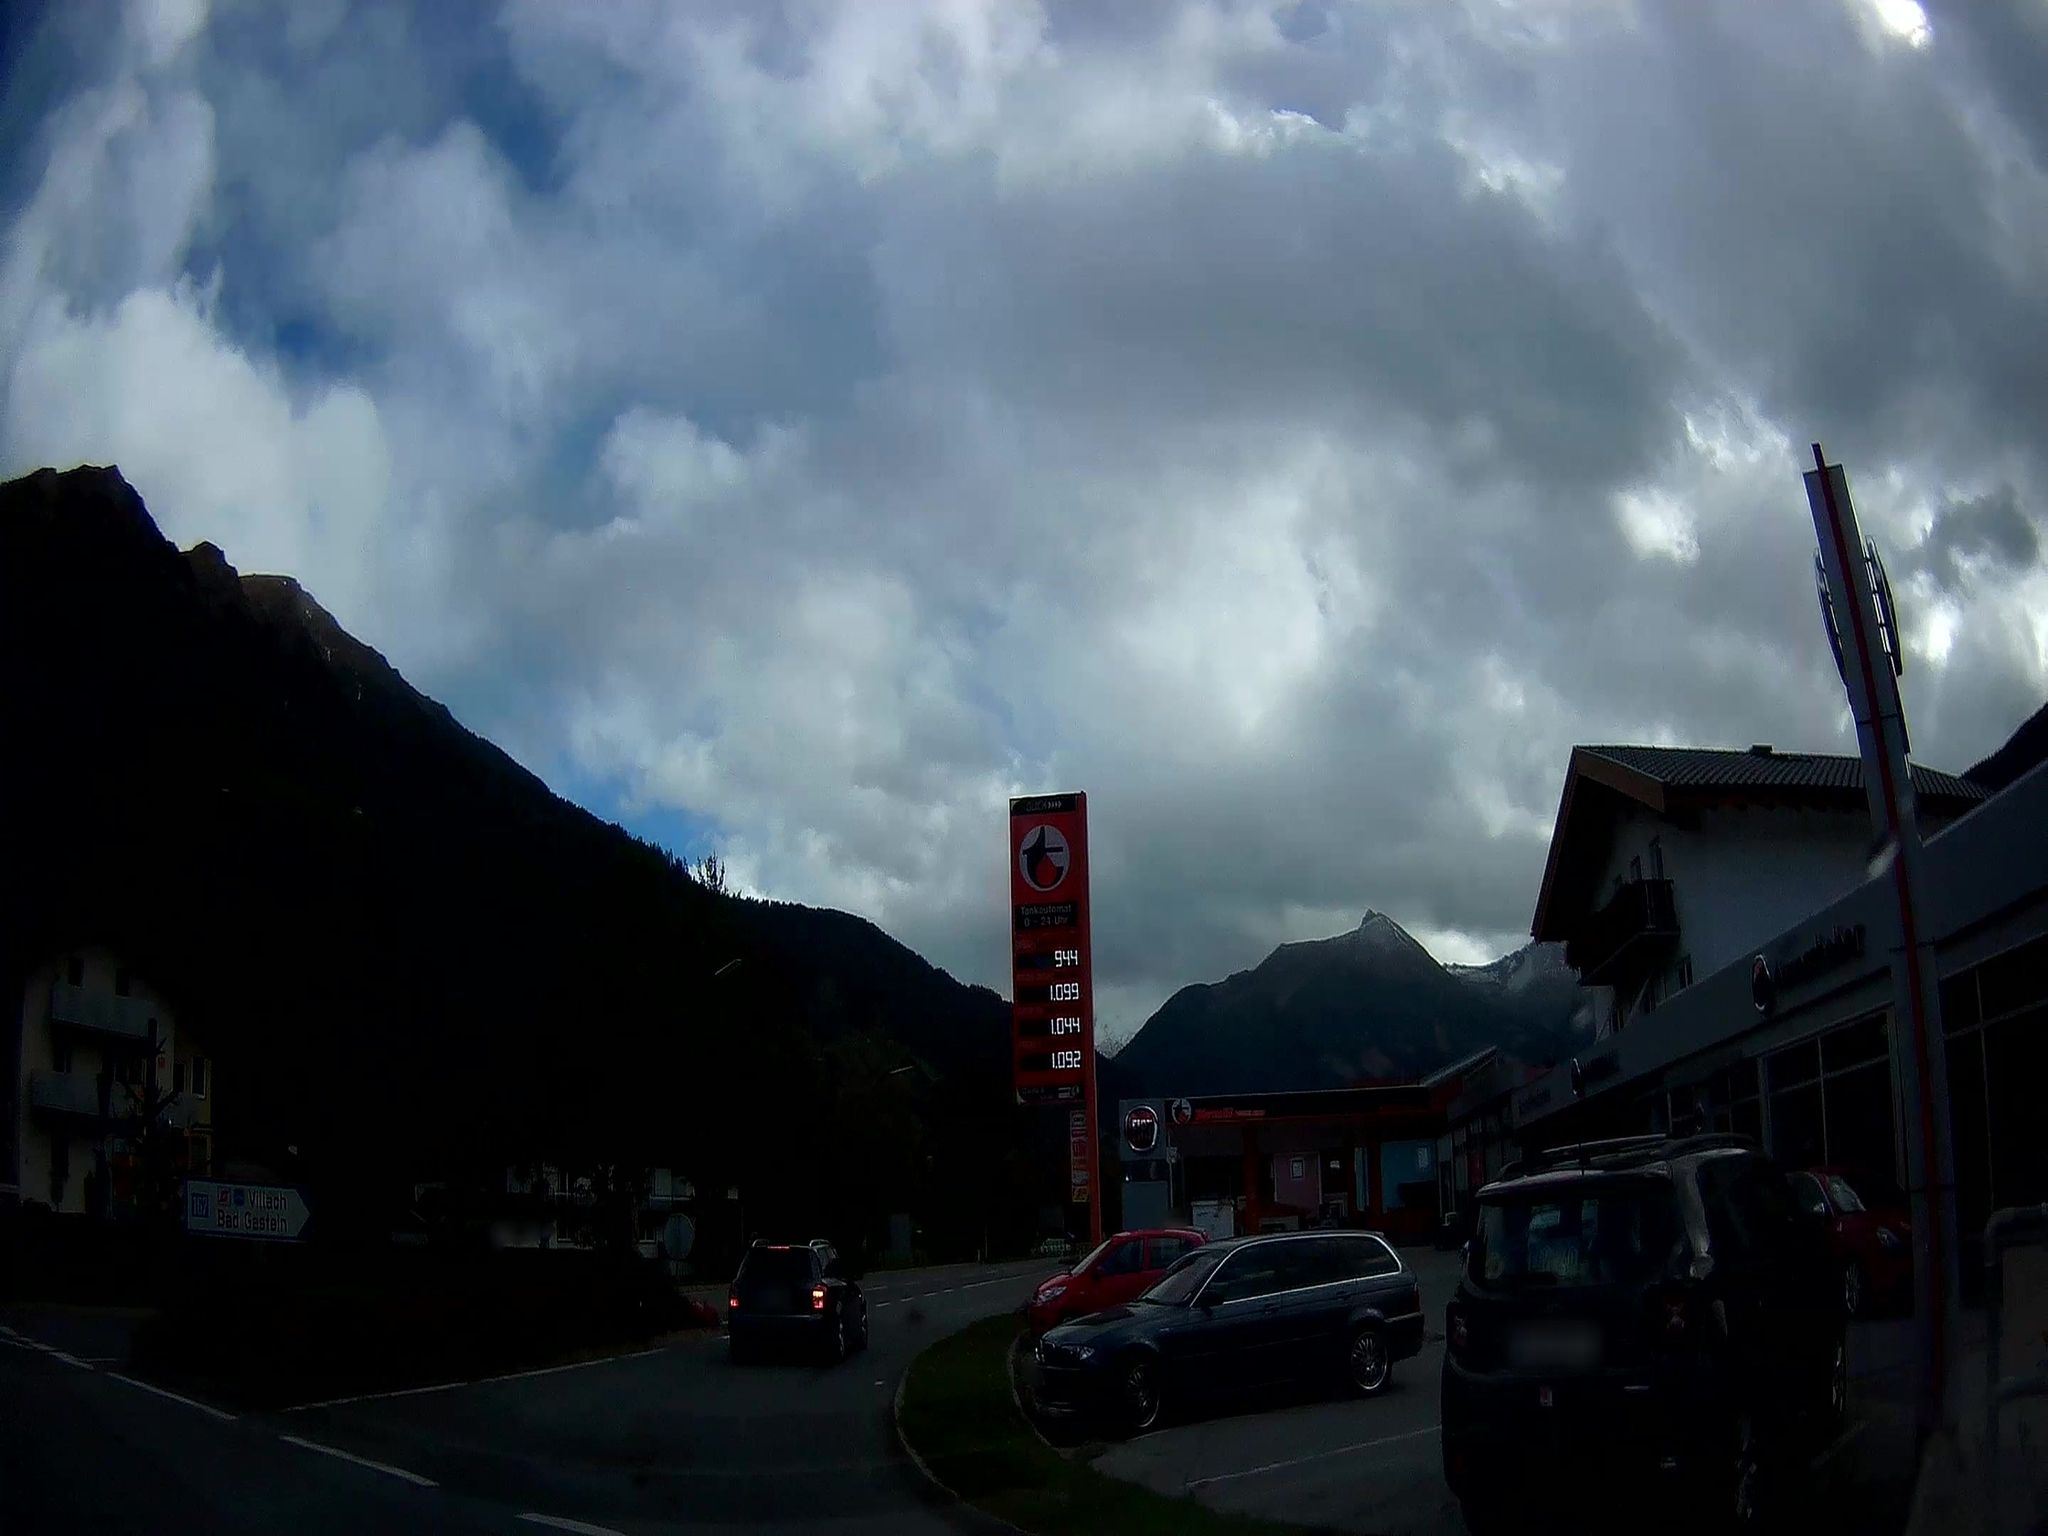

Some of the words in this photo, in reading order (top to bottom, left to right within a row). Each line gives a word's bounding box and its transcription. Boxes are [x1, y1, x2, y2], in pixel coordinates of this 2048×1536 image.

[1021, 904, 1072, 915] Tankautomat
[1054, 950, 1079, 967] 944
[1050, 983, 1079, 1001] 1.099
[1050, 1018, 1080, 1036] 1.044
[1051, 1050, 1081, 1069] 1.092
[1132, 1118, 1152, 1128] FIAT
[249, 1190, 287, 1210] Villach
[217, 1210, 239, 1229] Bad
[244, 1211, 287, 1232] Gastein
